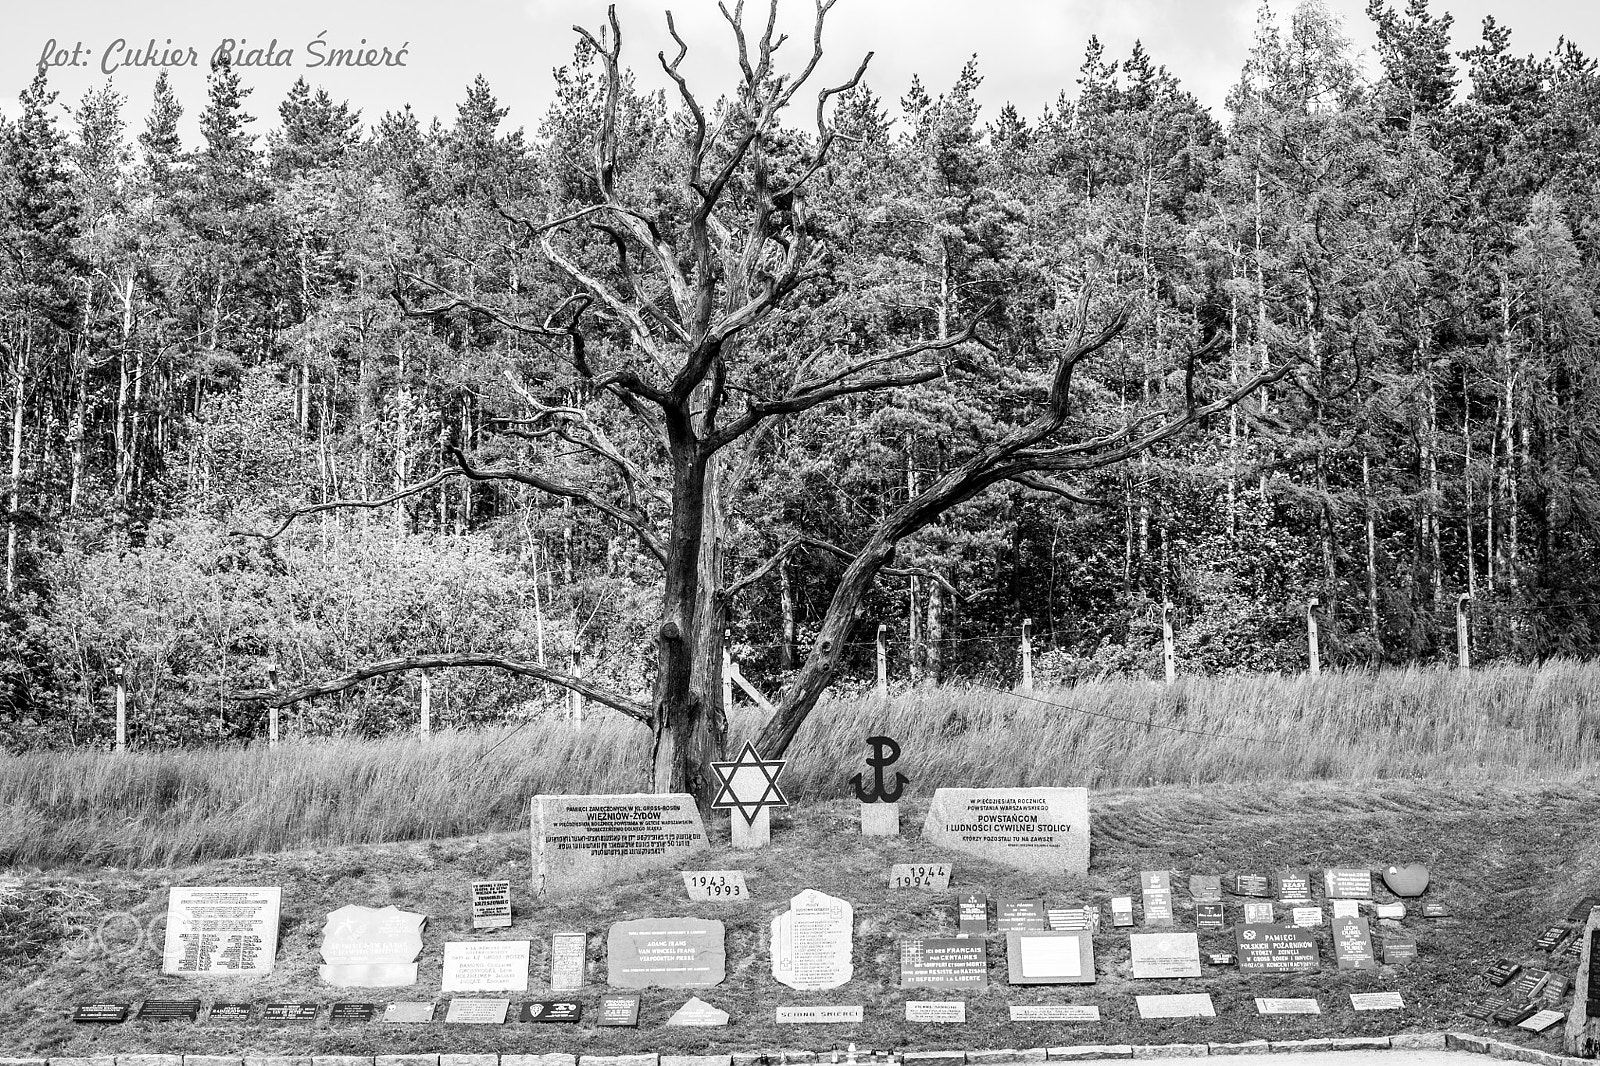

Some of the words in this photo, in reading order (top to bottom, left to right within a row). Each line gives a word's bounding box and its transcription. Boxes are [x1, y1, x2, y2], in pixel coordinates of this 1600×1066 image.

[977, 813, 1038, 823] POWSTAŃCOM
[951, 823, 992, 832] LUDNOŚCI
[994, 824, 1035, 832] CYWILNEJ
[1037, 824, 1071, 832] STOLICY
[911, 867, 944, 877] 1944
[692, 876, 725, 887] 1943
[896, 877, 930, 887] 1994
[706, 885, 740, 896] 1993
[1264, 934, 1296, 942] PAMIĘCI
[1272, 941, 1313, 949] POŻARNIKÓW
